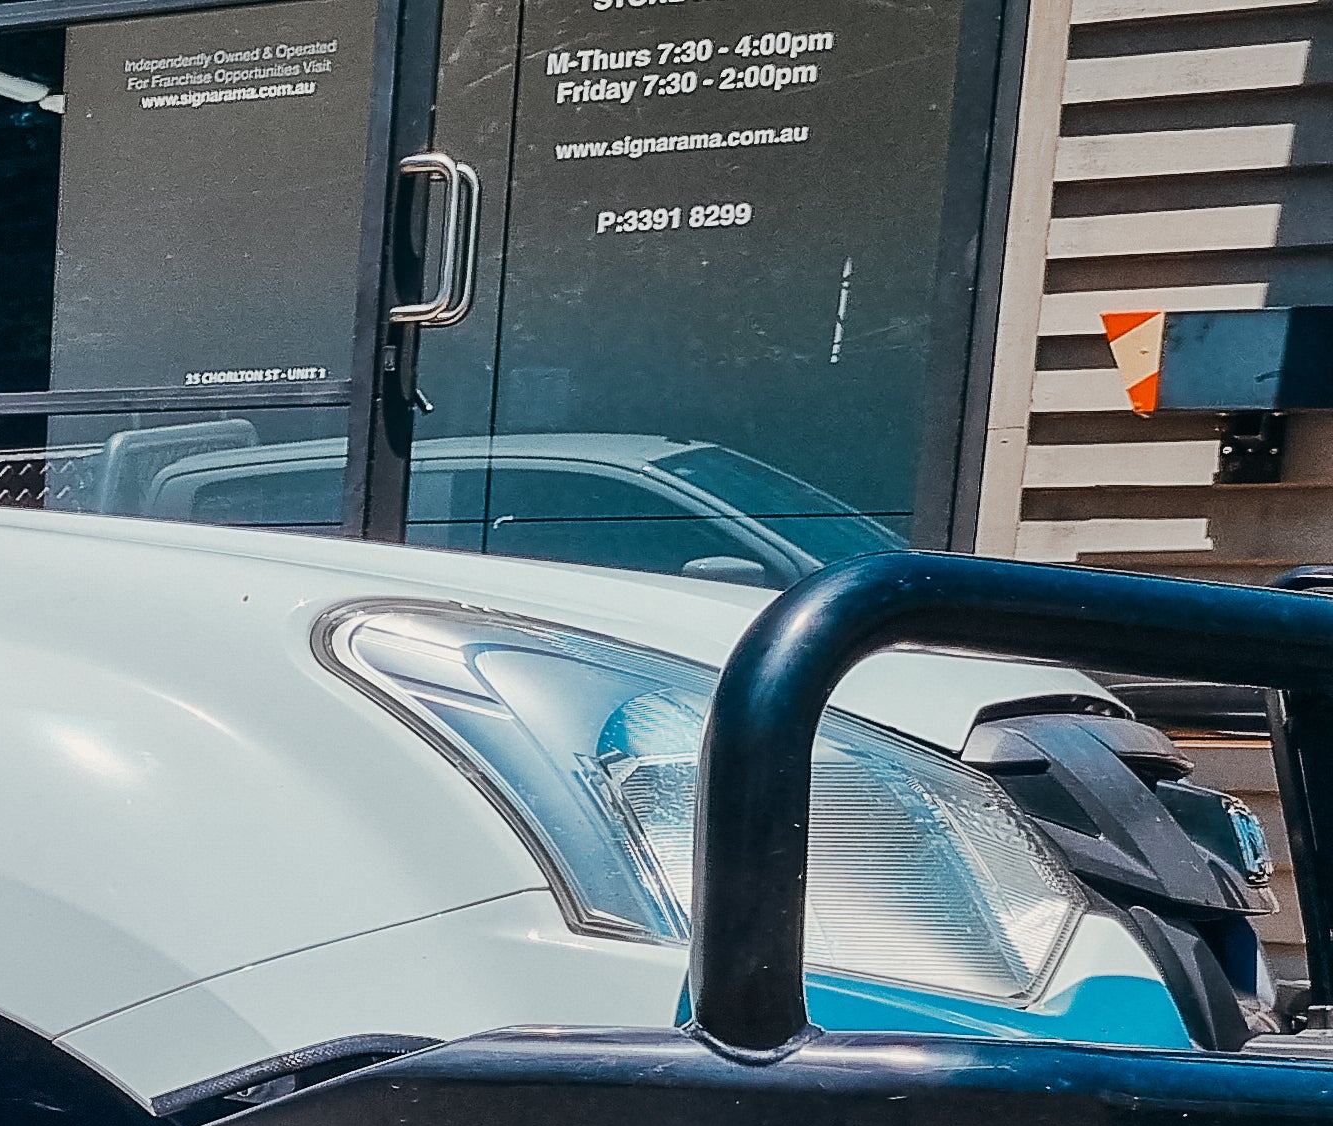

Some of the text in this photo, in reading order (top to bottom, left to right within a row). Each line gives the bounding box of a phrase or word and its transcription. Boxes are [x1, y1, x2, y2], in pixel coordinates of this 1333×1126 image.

[124, 40, 337, 73] Independently Owned & Operated
[546, 49, 652, 75] M-Thurs
[656, 39, 714, 65] 7:30
[734, 31, 835, 58] 4:00pm
[127, 58, 332, 90] For Franchise Opportunities Visit
[556, 78, 637, 104] Friday
[642, 71, 698, 97] 7:30
[718, 64, 818, 91] 2:00pm
[141, 81, 317, 108] www.signarama.com.au
[555, 126, 810, 160] www.signarama.com.au
[596, 202, 752, 233] P:3391 8299
[201, 369, 264, 384] CHORLTON
[264, 368, 282, 381] ST
[287, 367, 318, 380] UNIT
